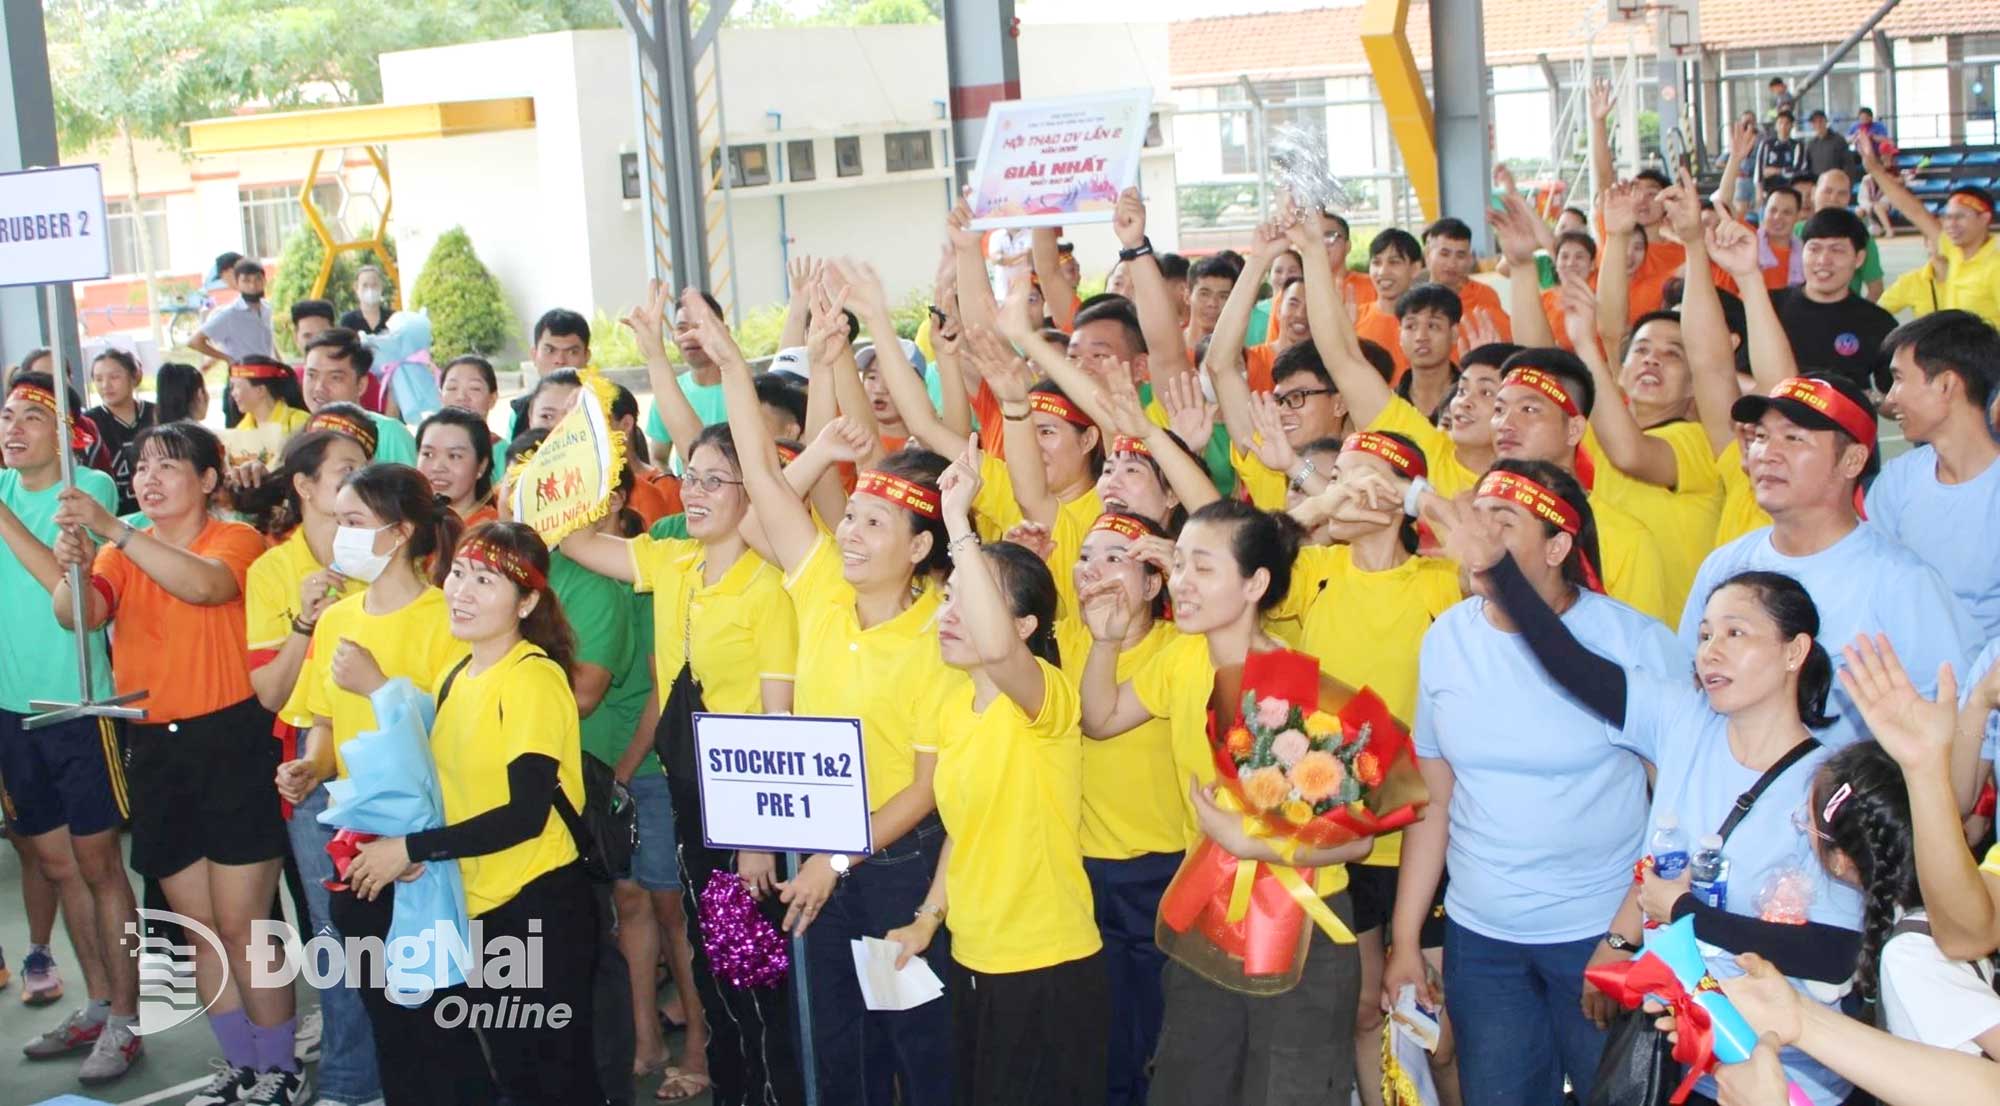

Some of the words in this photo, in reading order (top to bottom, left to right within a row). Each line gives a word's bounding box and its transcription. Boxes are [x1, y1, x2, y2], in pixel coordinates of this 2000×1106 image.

[1004, 160, 1046, 180] GIẢI
[1052, 155, 1108, 175] NHẤT
[0, 213, 71, 243] RUBBER
[78, 210, 91, 236] 2
[709, 748, 806, 776] STOCKFIT
[812, 752, 852, 778] 1&2
[756, 791, 795, 817] PRE
[800, 794, 811, 818] 1
